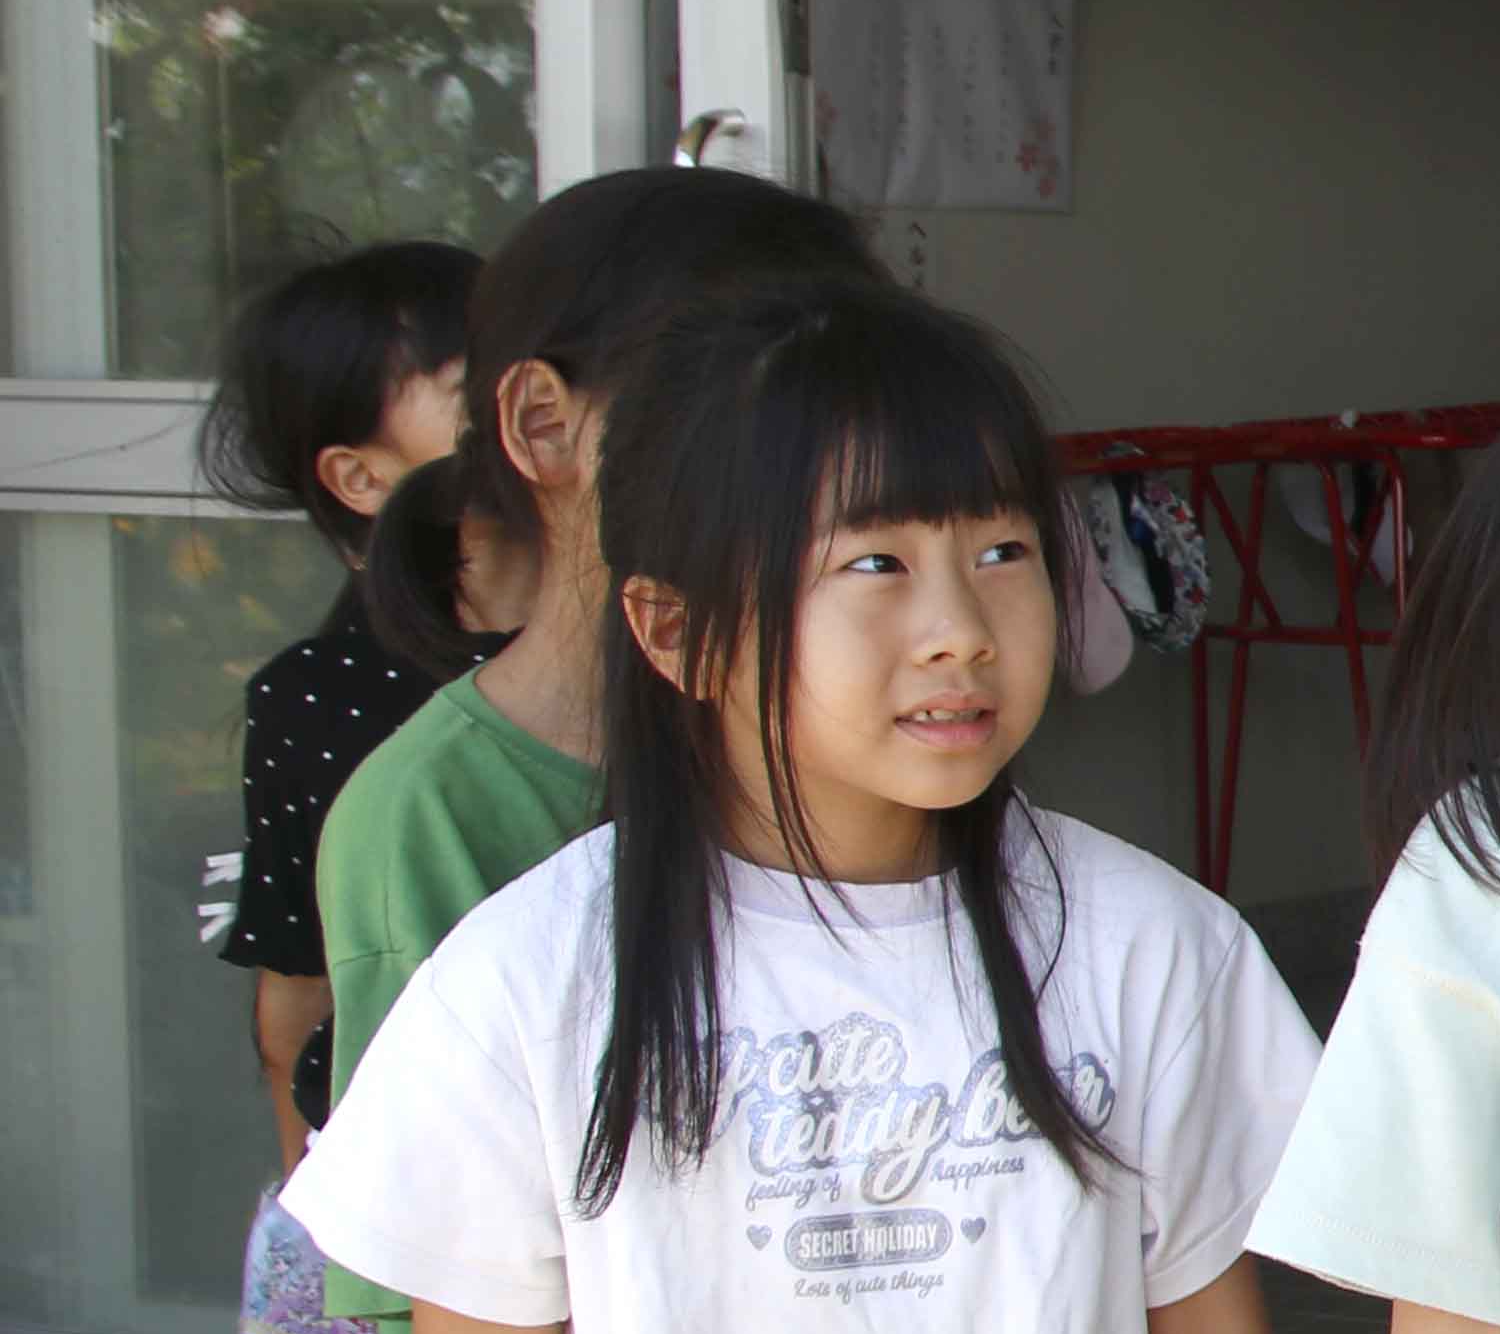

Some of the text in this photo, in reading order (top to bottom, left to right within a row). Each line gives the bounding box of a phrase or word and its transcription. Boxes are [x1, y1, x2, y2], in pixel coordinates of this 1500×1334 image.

[766, 1017, 904, 1097] cute
[755, 1085, 948, 1202] teddy
[746, 1155, 1025, 1211] feeling of happiness
[799, 1223, 938, 1260] SECRET HOLIDAY
[836, 1277, 852, 1305] of
[855, 1275, 887, 1294] cute
[890, 1270, 944, 1299] things
